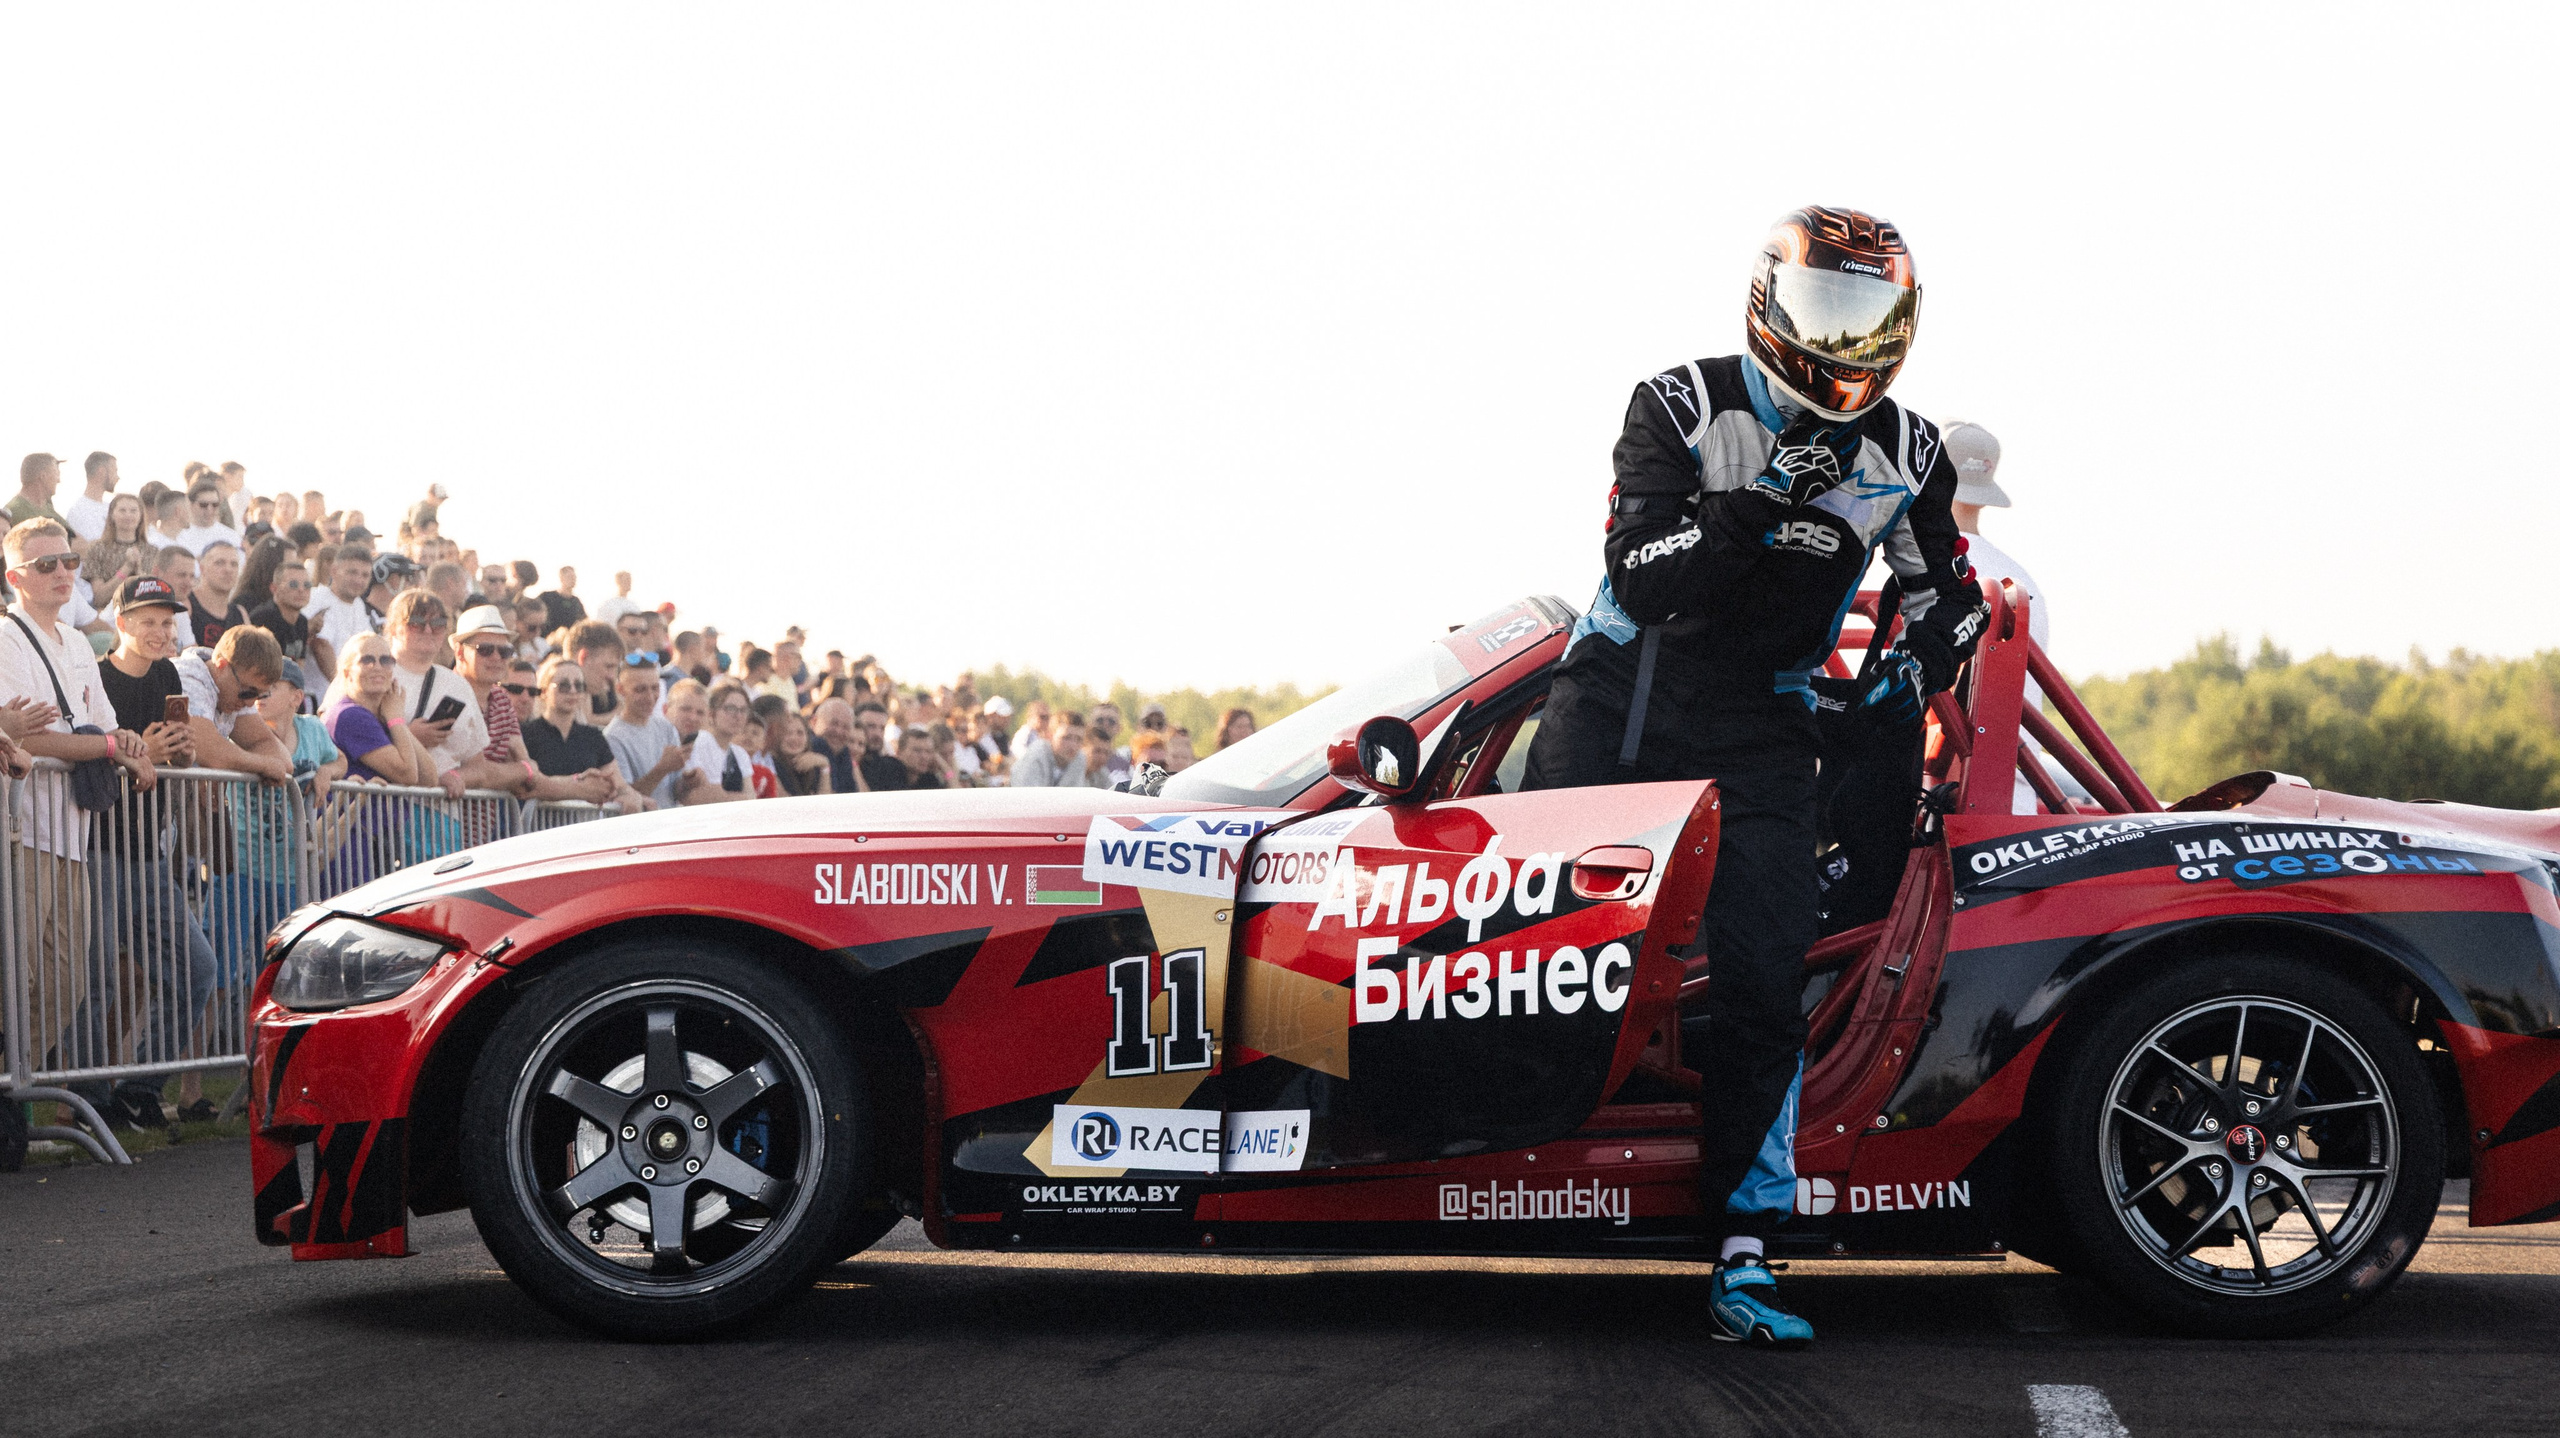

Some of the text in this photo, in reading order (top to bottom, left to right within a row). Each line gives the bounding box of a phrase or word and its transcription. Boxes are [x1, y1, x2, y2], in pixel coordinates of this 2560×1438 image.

[2042, 851, 2066, 865] CAR
[2103, 831, 2145, 847] STUDIO
[2174, 839, 2235, 863] НА
[2240, 832, 2390, 855] ШИНАХ
[815, 864, 1013, 905] SLABODSKI V.
[1307, 835, 1565, 943] Альфа
[1356, 936, 1632, 1023] Бизнес
[1107, 948, 1213, 1079] 11
[1023, 1185, 1181, 1203] OKLEYKA.BY
[1439, 1179, 1630, 1225] @slabodsky
